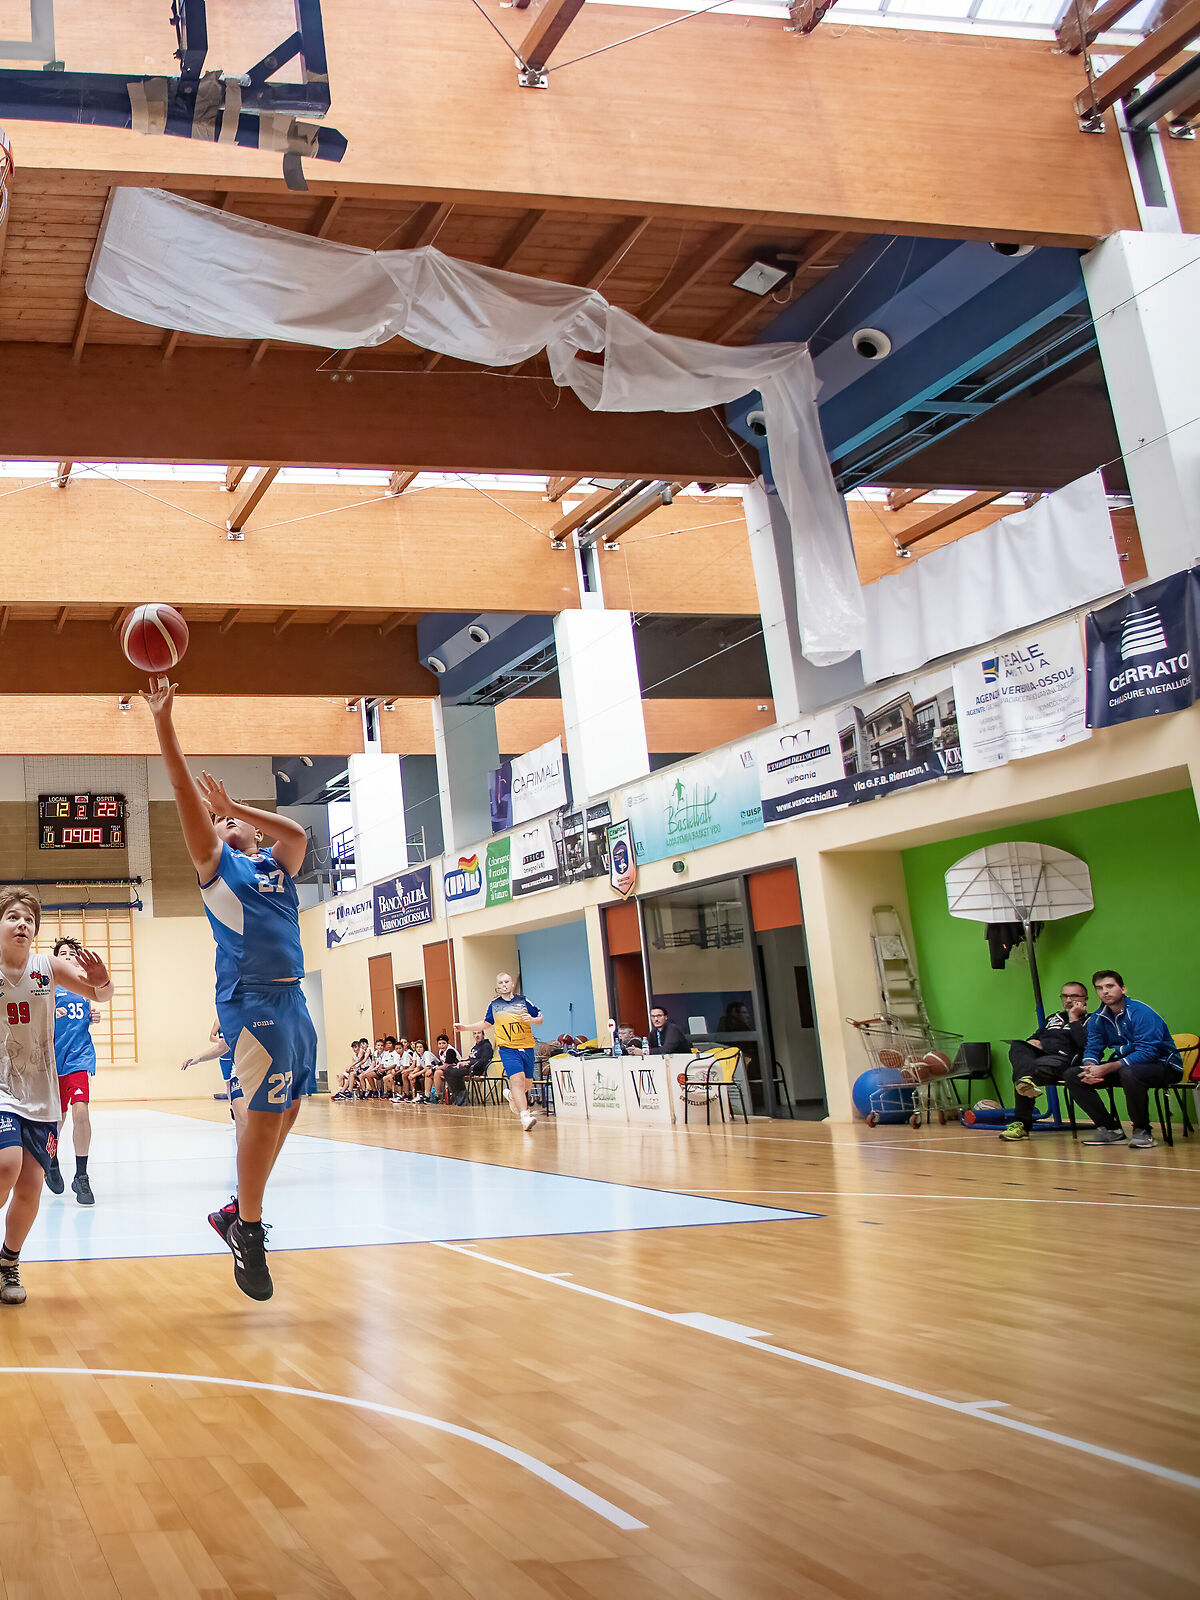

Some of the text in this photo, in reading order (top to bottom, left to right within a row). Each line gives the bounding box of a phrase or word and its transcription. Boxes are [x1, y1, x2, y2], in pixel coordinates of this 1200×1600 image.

[1109, 653, 1190, 692] CERRATO
[1109, 687, 1145, 707] CHIUSURE
[853, 778, 866, 791] Via
[56, 802, 69, 817] 12
[78, 805, 85, 817] 2
[98, 802, 117, 817] 22
[47, 832, 54, 843] 0
[113, 831, 120, 842] 0
[254, 869, 285, 893] 27
[6, 1001, 31, 1025] 99
[67, 1002, 84, 1020] 35
[501, 1021, 526, 1042] VOX
[267, 1070, 293, 1105] 27
[554, 1069, 577, 1104] VOX
[629, 1069, 658, 1109] VOX
